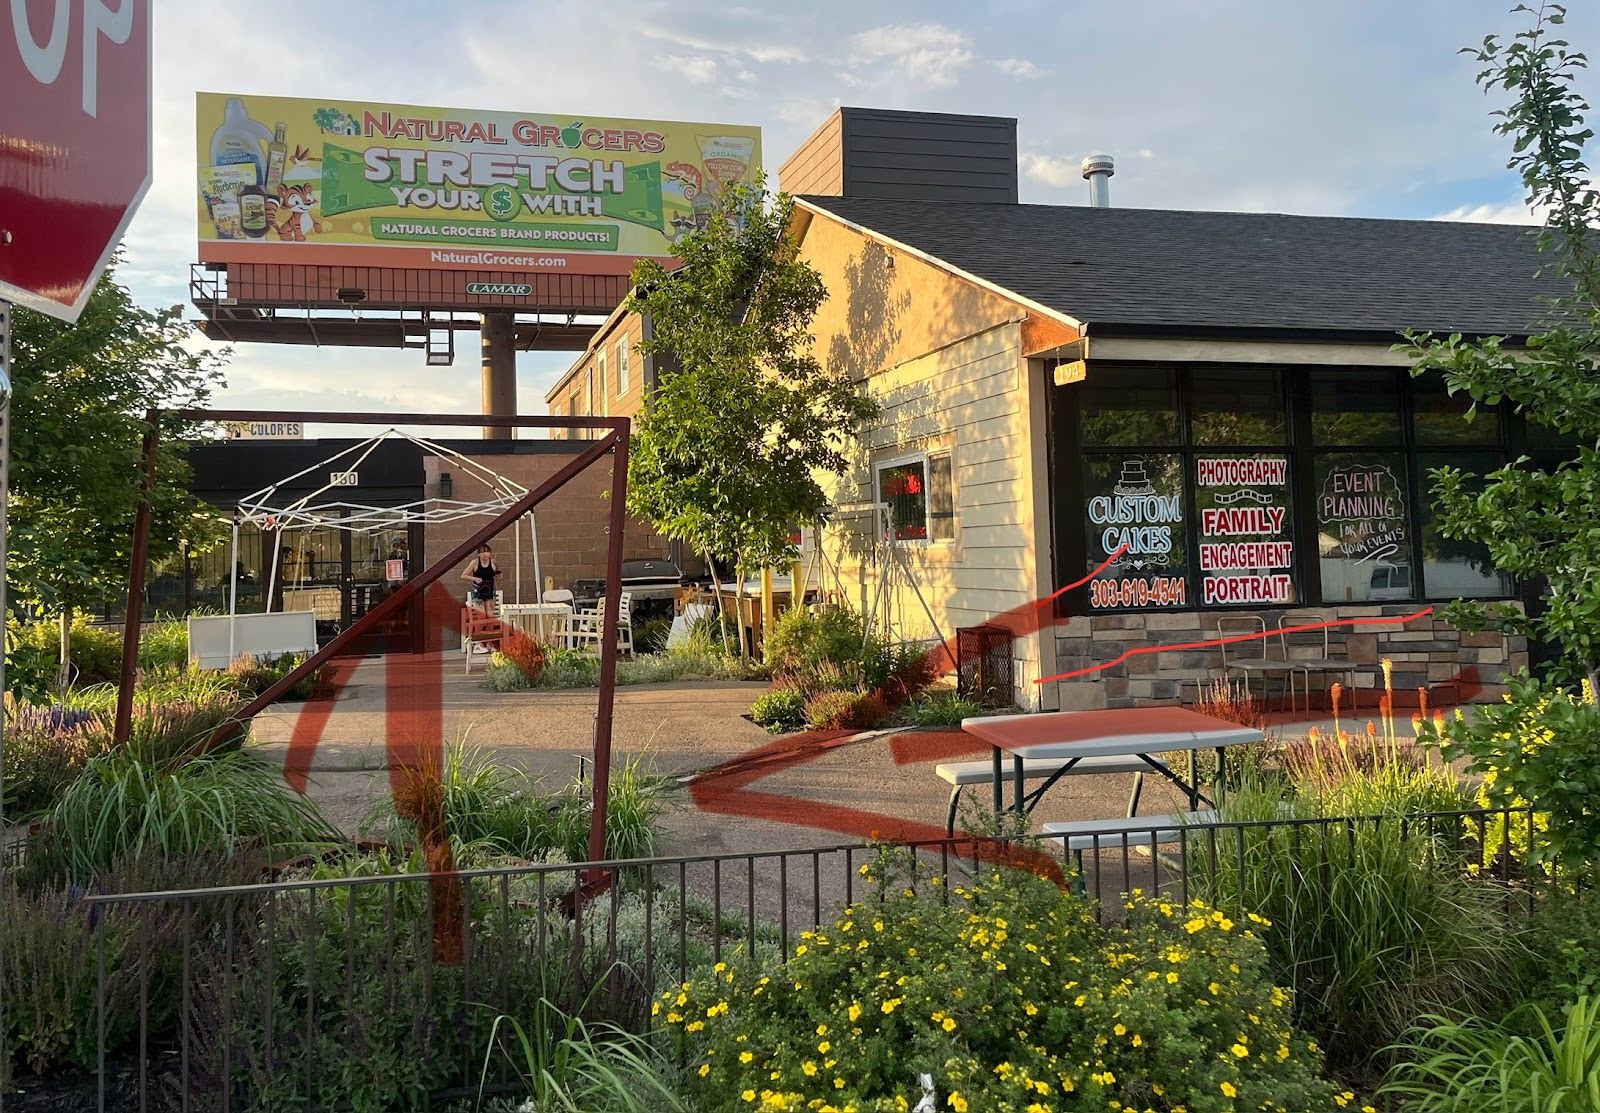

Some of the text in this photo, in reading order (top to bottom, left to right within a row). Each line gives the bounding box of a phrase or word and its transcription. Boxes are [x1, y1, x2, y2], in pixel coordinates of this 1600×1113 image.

[363, 111, 665, 153] NATURAL GROCERS
[363, 147, 625, 194] STRETCH
[390, 187, 483, 212] YOUR
[521, 193, 602, 216] WITH
[381, 223, 610, 243] NATURAL GROCERS BRAND PRODUCTS!
[430, 250, 567, 268] NaturalGrocers.com
[471, 284, 526, 294] LAMAR
[1197, 458, 1287, 486] PHOTOGRAPHY
[1333, 471, 1384, 493] EVENT
[1088, 495, 1182, 524] CUSTOM
[1202, 506, 1286, 537] FAMILY
[1323, 496, 1395, 518] PLANNING
[1101, 526, 1173, 555] CAKES
[1359, 522, 1375, 535] ALL
[1200, 541, 1293, 570] ENGAGEMENT
[1340, 527, 1405, 560] YOUR EVENTS
[1090, 577, 1186, 608] 303-619-4541
[1203, 574, 1291, 604] PORTRAIT
